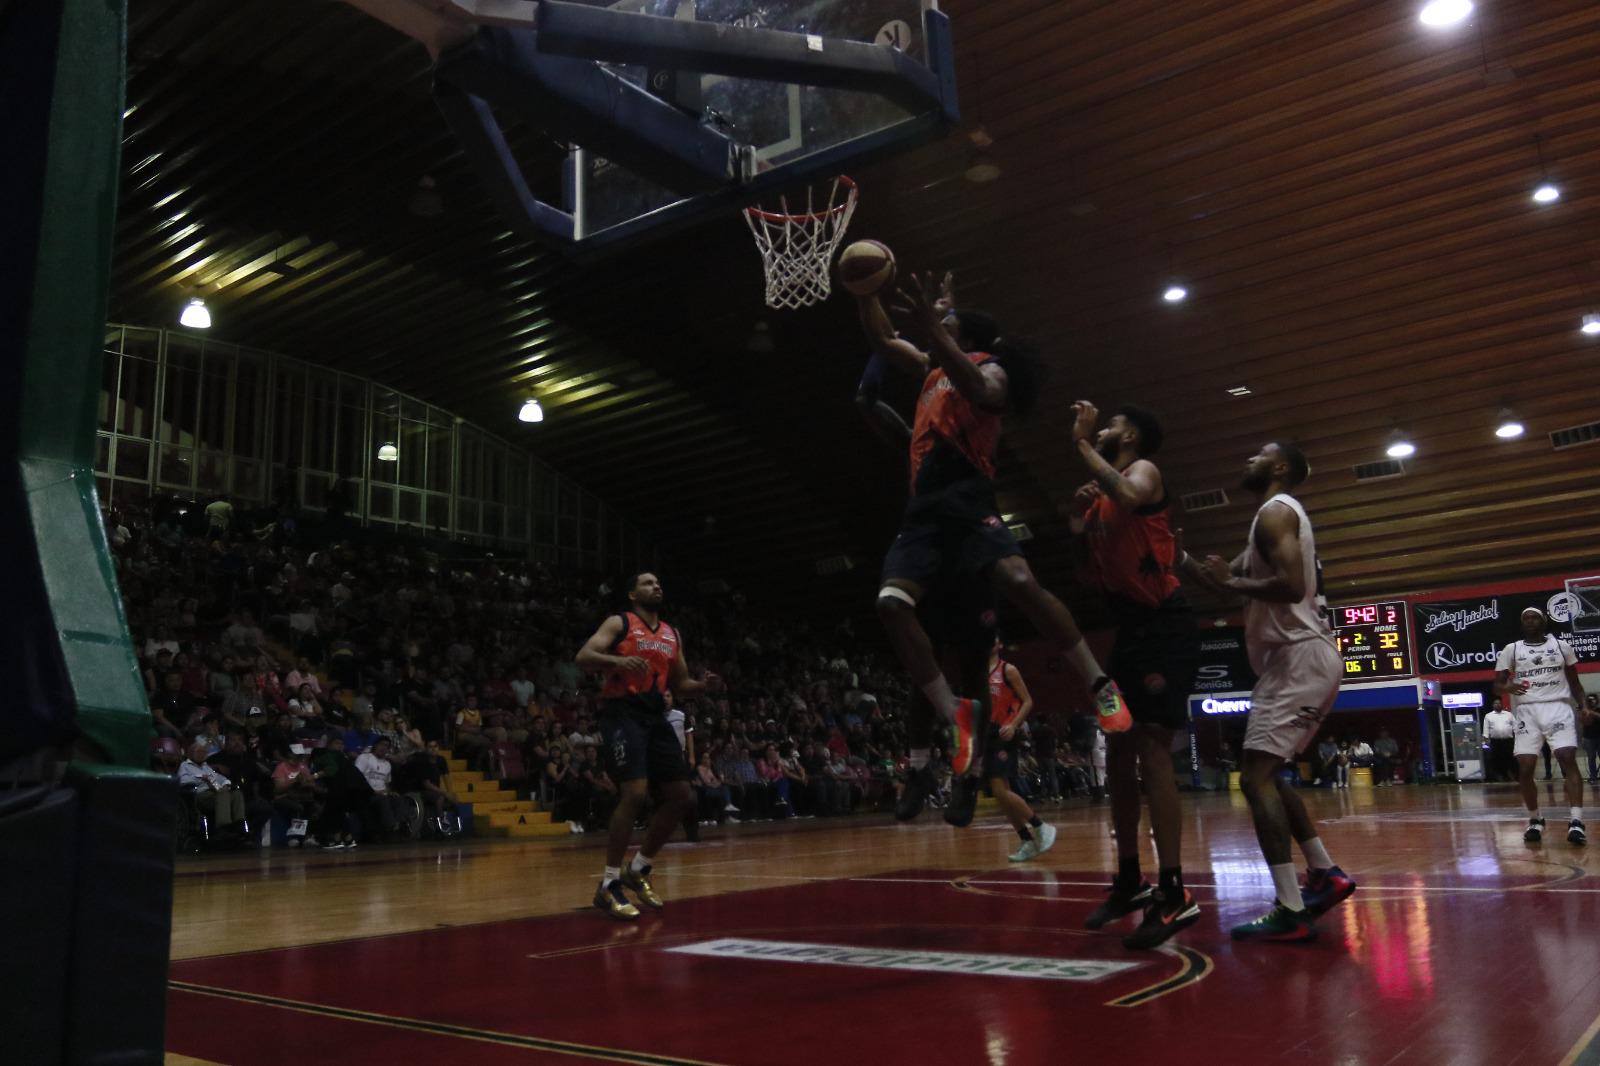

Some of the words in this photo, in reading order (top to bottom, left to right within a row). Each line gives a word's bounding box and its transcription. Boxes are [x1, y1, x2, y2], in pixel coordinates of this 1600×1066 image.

[1345, 607, 1376, 624] 9:42
[1387, 611, 1396, 623] 2
[1424, 611, 1453, 633] Salsa
[1452, 599, 1500, 632] Huichol
[1353, 633, 1363, 645] 2
[1379, 633, 1399, 649] 32
[1572, 644, 1598, 652] rivada
[1345, 661, 1361, 672] 06
[1371, 660, 1377, 670] 1
[1392, 657, 1403, 670] 0
[1194, 680, 1233, 689] SoniGas
[518, 815, 527, 825] A
